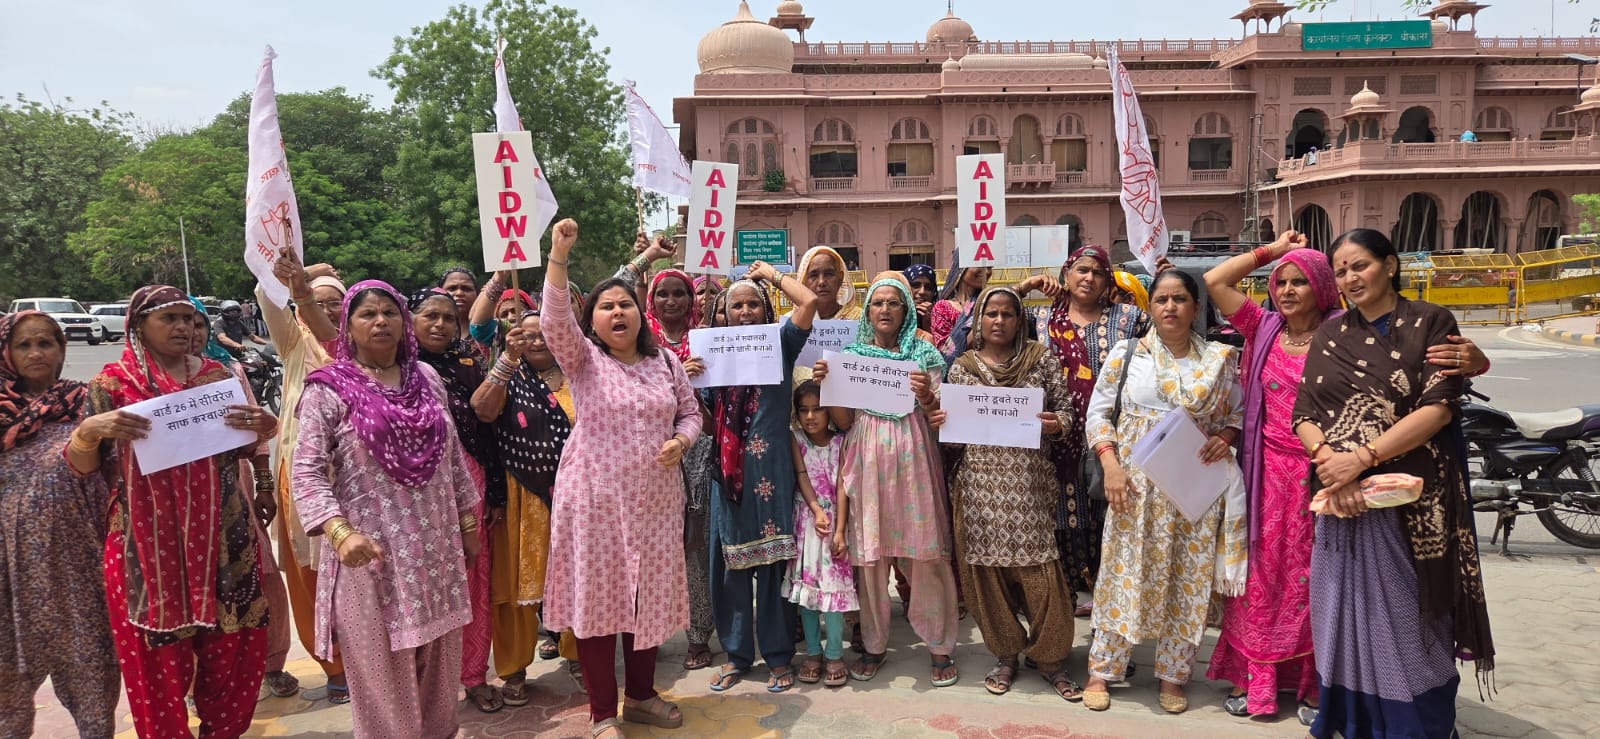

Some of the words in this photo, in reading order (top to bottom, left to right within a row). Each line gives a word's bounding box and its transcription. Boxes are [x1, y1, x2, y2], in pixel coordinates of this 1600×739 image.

[493, 140, 528, 263] AIDWA
[970, 161, 998, 261] AIDWA
[699, 169, 727, 269] AIDWA
[807, 337, 817, 346] को
[819, 338, 841, 347] बचाओ
[842, 361, 858, 371] वार्ड
[860, 365, 871, 373] 26
[872, 364, 880, 374] में
[881, 366, 910, 377] सीवरेज
[849, 375, 867, 384] साफ
[869, 377, 901, 389] करवाओ
[152, 403, 172, 418] वार्ड
[175, 404, 187, 413] 26
[189, 398, 197, 409] में
[199, 390, 234, 406] सीवरेज
[968, 393, 989, 403] हमारे
[1013, 395, 1029, 405] घरों
[166, 418, 189, 431] साफ
[191, 406, 230, 425] करवाओ
[977, 406, 989, 415] को
[991, 407, 1018, 417] बचाओ
